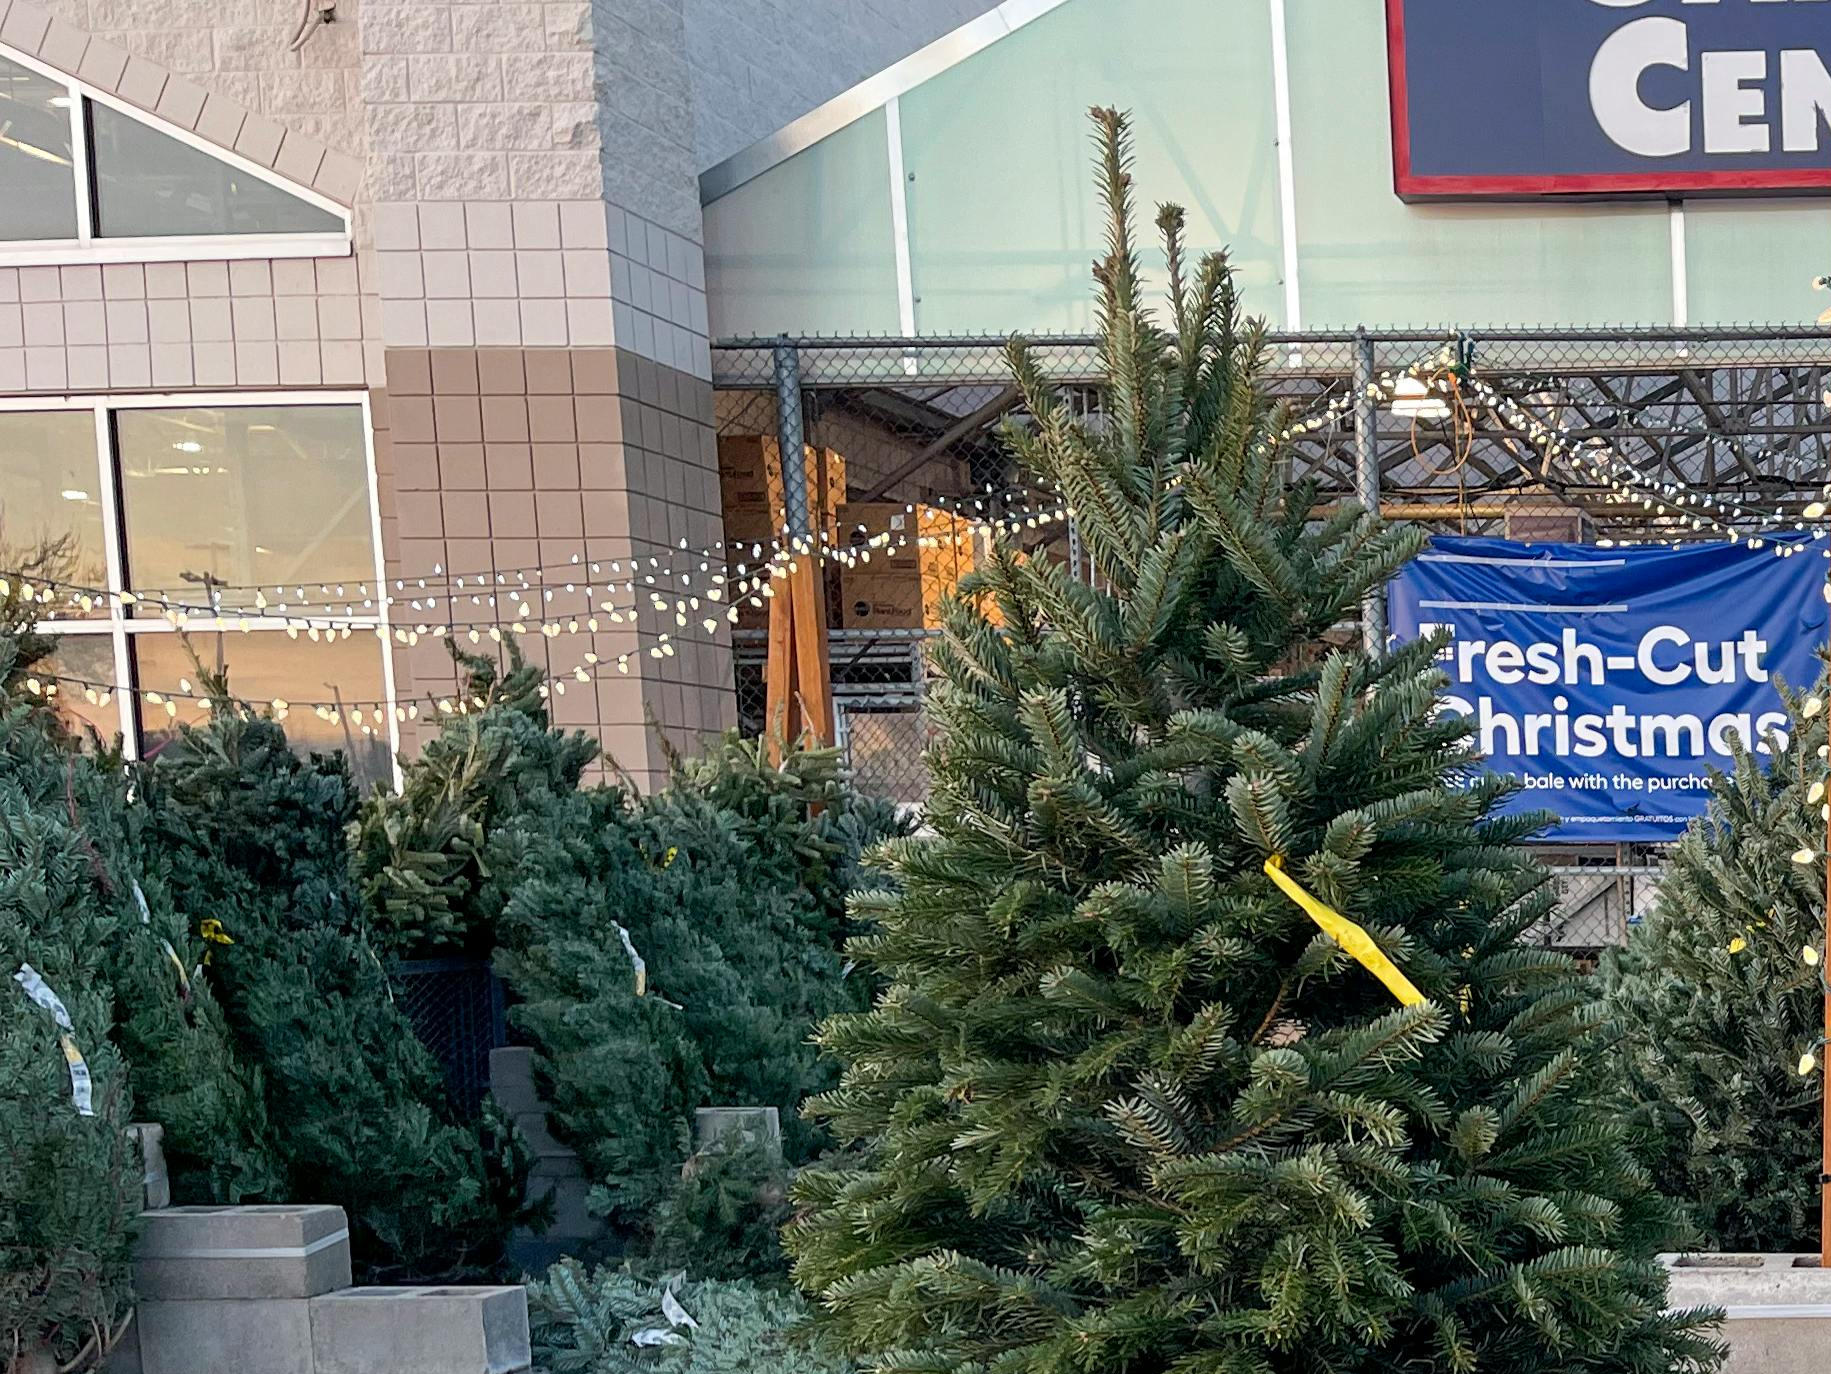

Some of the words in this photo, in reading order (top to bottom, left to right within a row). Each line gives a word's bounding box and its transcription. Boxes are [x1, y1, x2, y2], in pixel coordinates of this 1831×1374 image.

[1523, 772, 1565, 789] bale
[1568, 772, 1608, 789] with
[1611, 772, 1643, 790] the
[1648, 772, 1734, 794] purcha
[1634, 814, 1674, 823] GRATUITOS
